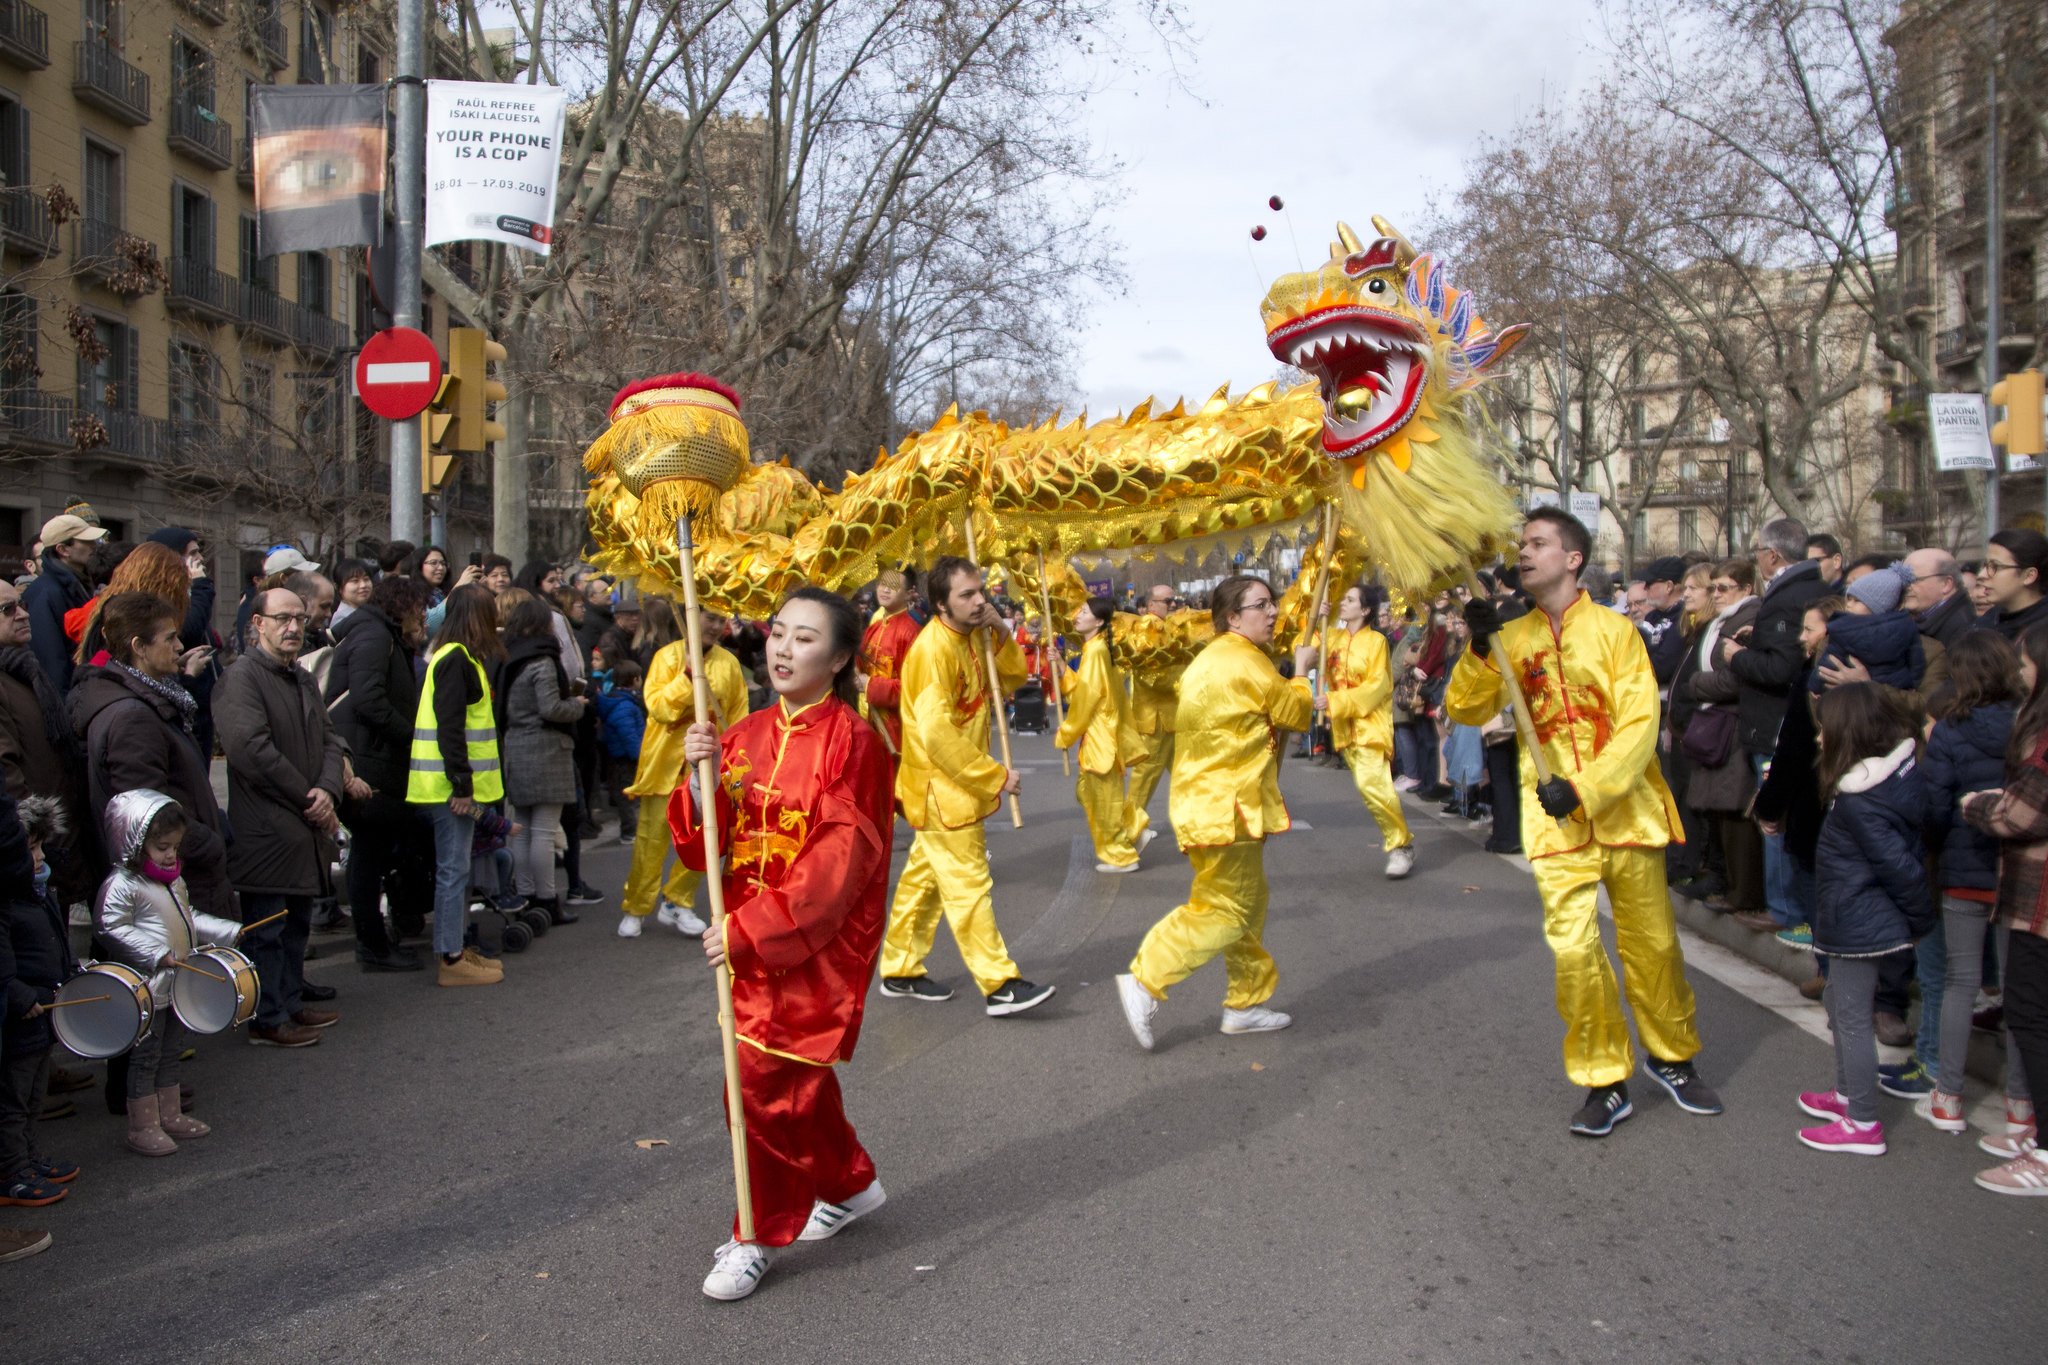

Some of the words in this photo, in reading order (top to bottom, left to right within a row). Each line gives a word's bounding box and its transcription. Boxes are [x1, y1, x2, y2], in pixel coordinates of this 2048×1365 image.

[457, 97, 487, 108] RAÜL
[490, 99, 536, 111] REFREE
[449, 109, 480, 119] ISAKI
[483, 111, 541, 124] LACUESTA
[436, 130, 484, 143] YOUR
[489, 132, 552, 149] PHONE
[455, 146, 471, 158] IS
[477, 147, 488, 159] A
[492, 148, 528, 161] COP
[434, 178, 462, 191] 18.01
[482, 178, 546, 197] 17.03.2019
[503, 222, 530, 233] Barcelona
[1937, 406, 1950, 416] LA
[1950, 406, 1978, 416] DONA
[1938, 415, 1981, 426] PANTERA
